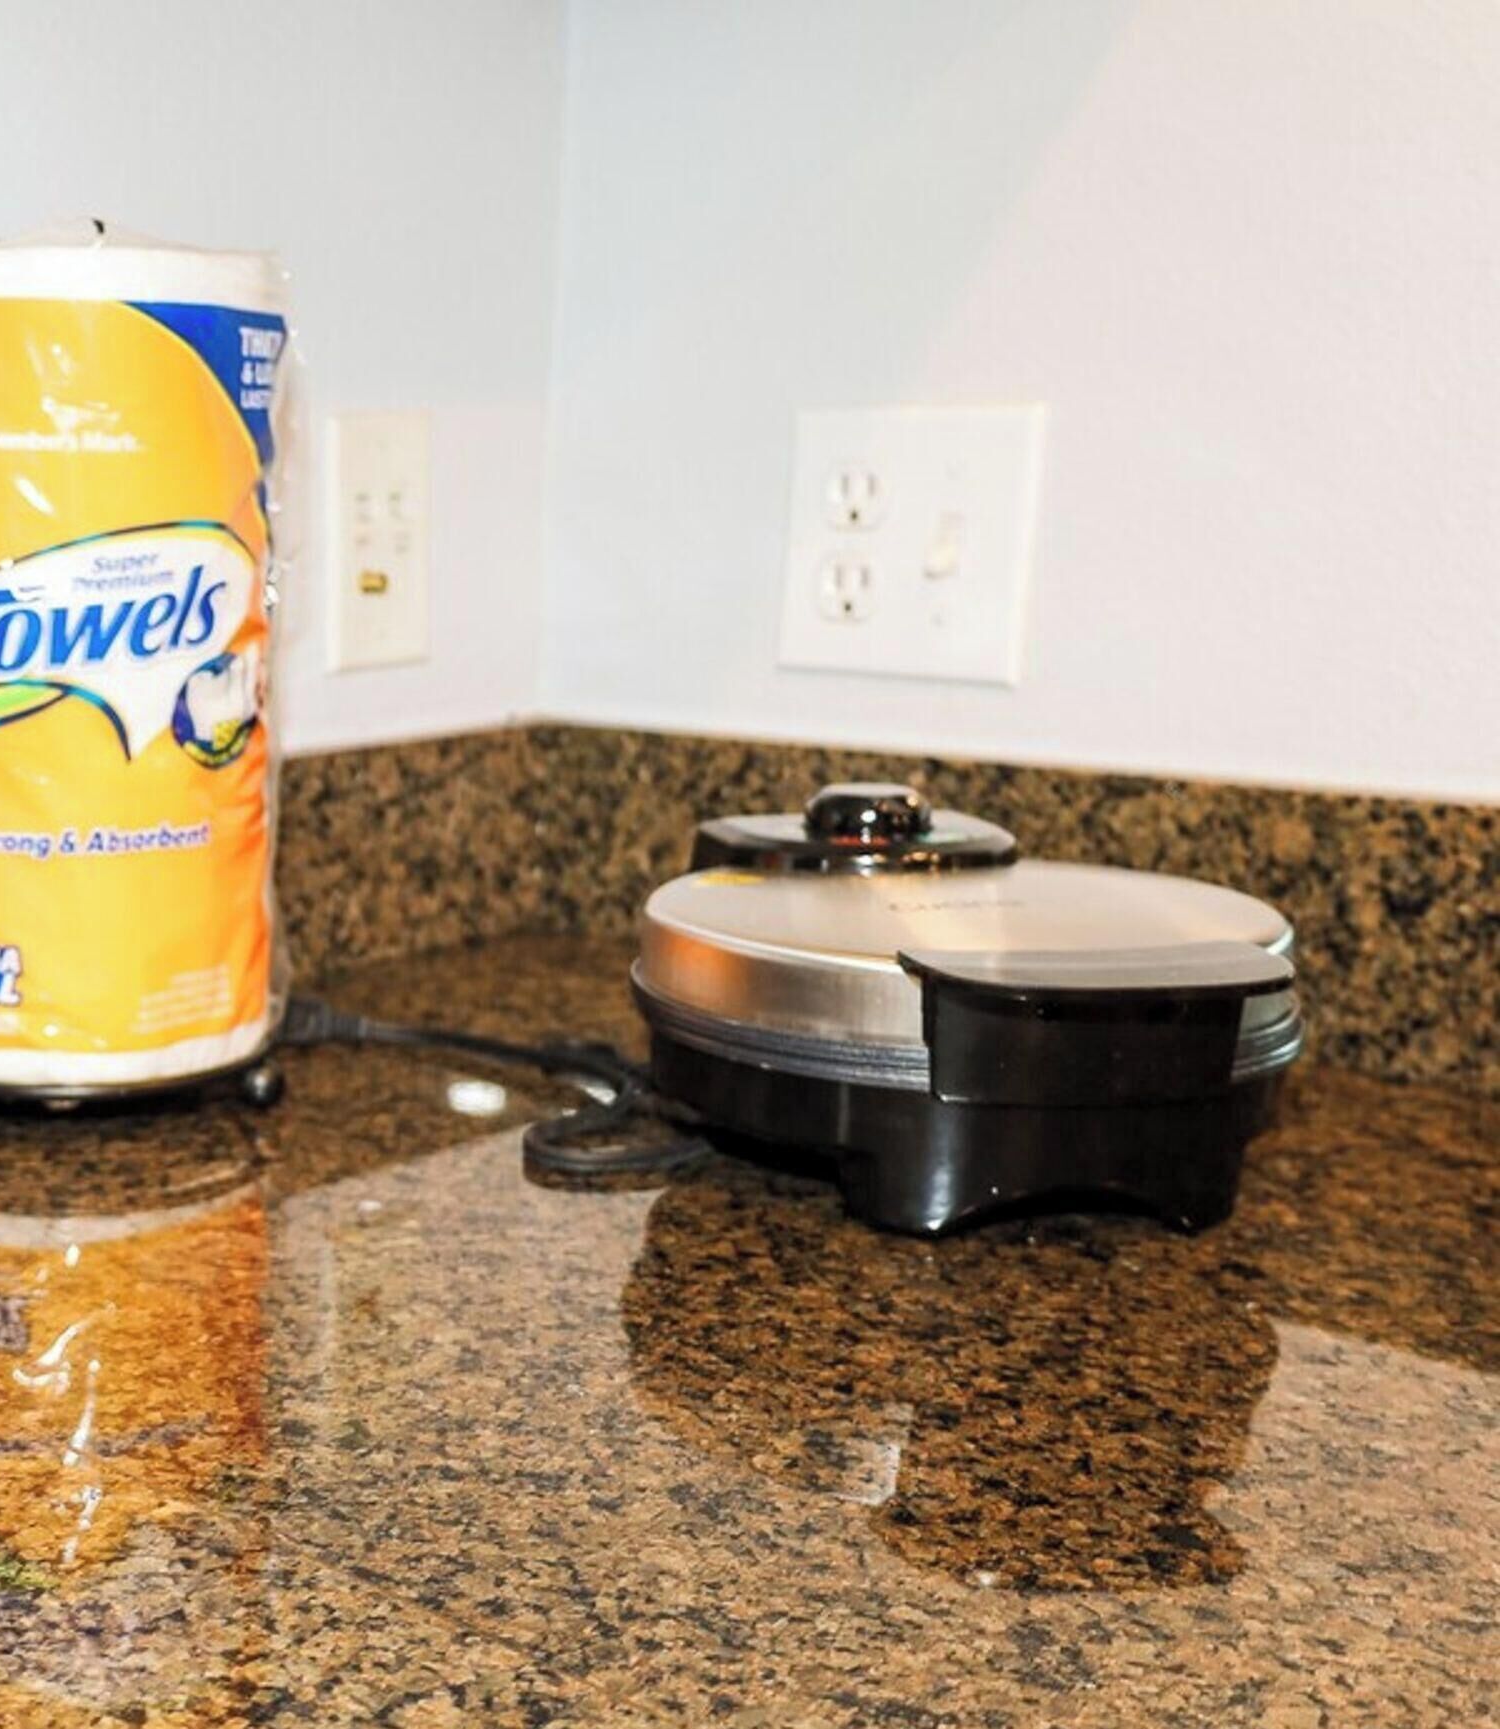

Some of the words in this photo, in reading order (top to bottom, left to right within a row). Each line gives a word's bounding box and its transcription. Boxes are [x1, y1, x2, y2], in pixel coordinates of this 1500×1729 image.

[91, 553, 160, 577] Super
[71, 570, 174, 592] Premium
[59, 831, 76, 853] &
[87, 823, 211, 853] Absorbent
